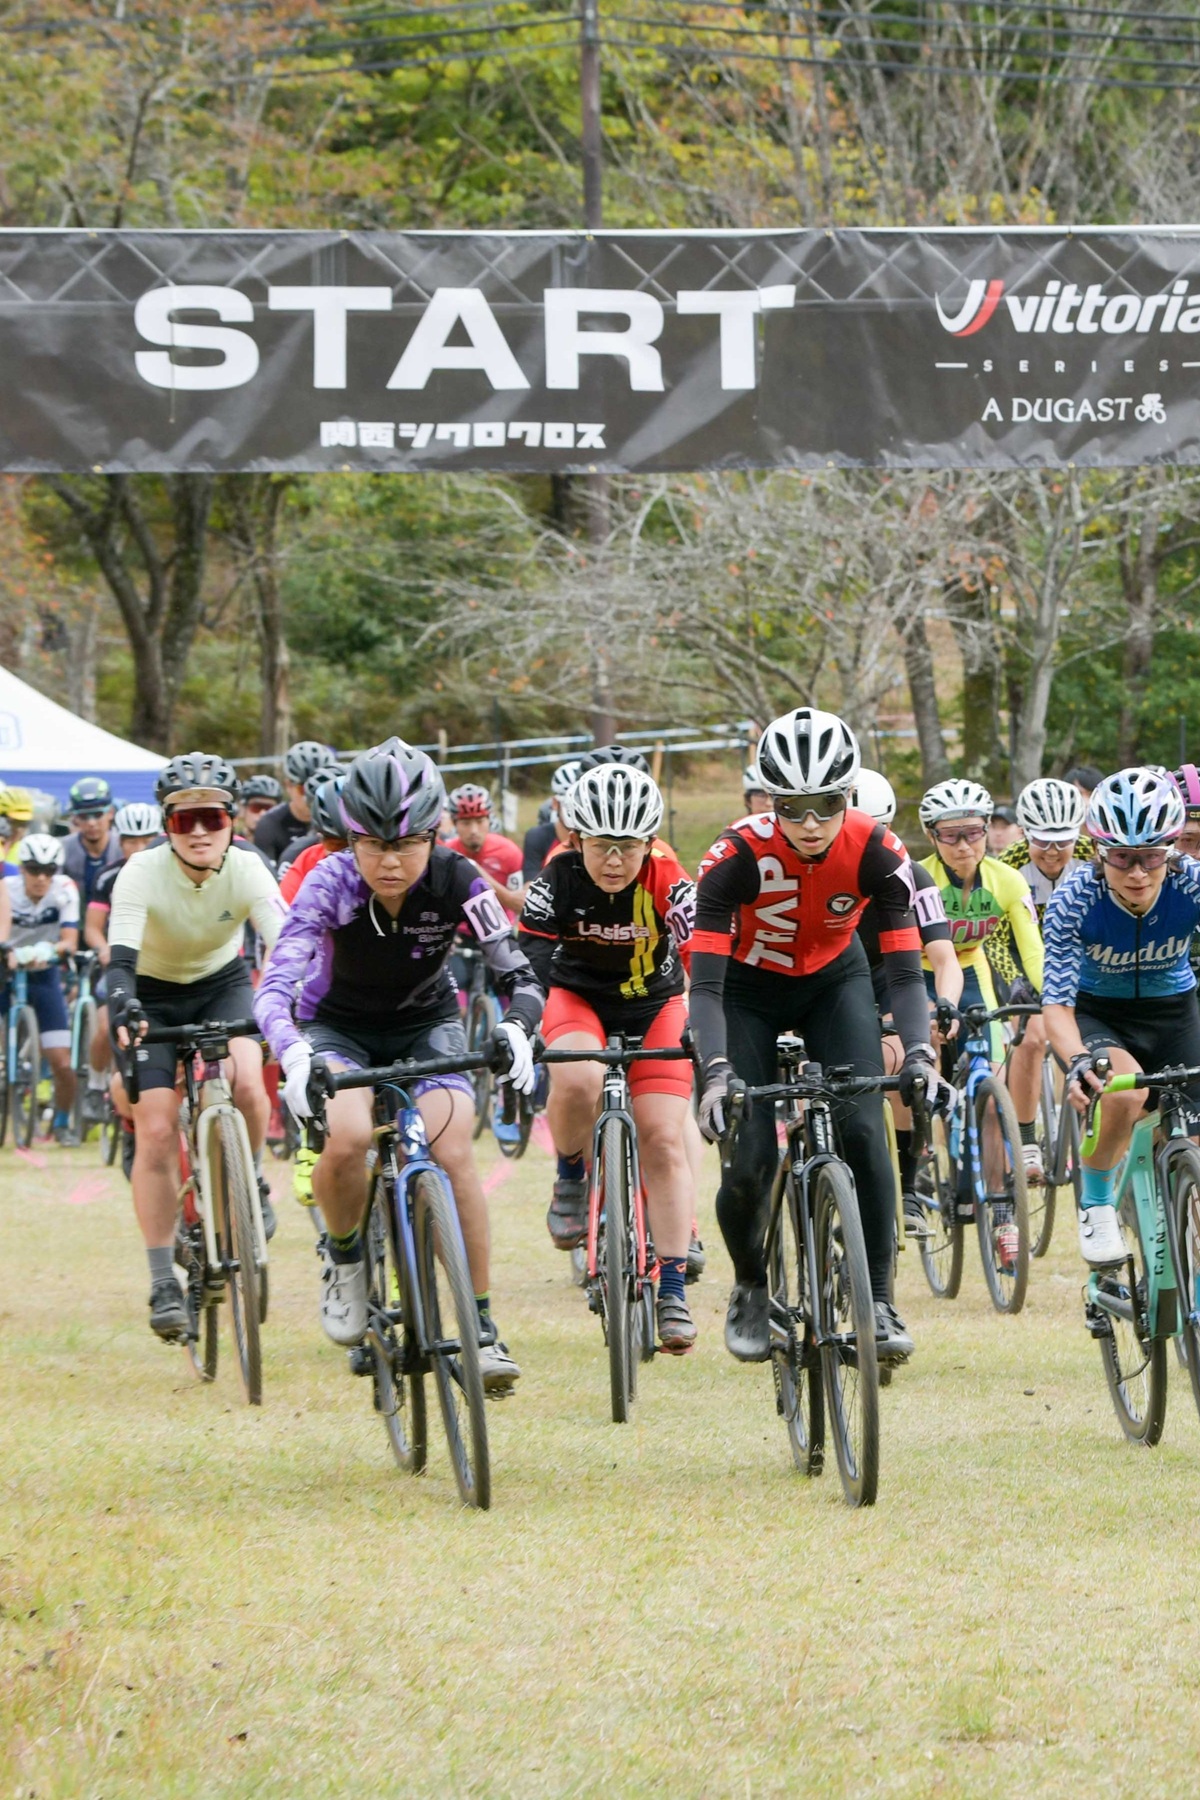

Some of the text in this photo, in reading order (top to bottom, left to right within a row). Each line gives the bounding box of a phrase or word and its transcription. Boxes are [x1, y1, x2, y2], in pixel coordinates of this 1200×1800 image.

[134, 284, 796, 392] START
[983, 360, 1169, 373] SERIES
[981, 398, 1133, 423] A DUGAST
[470, 898, 510, 937] 10
[1086, 934, 1192, 967] Muddy
